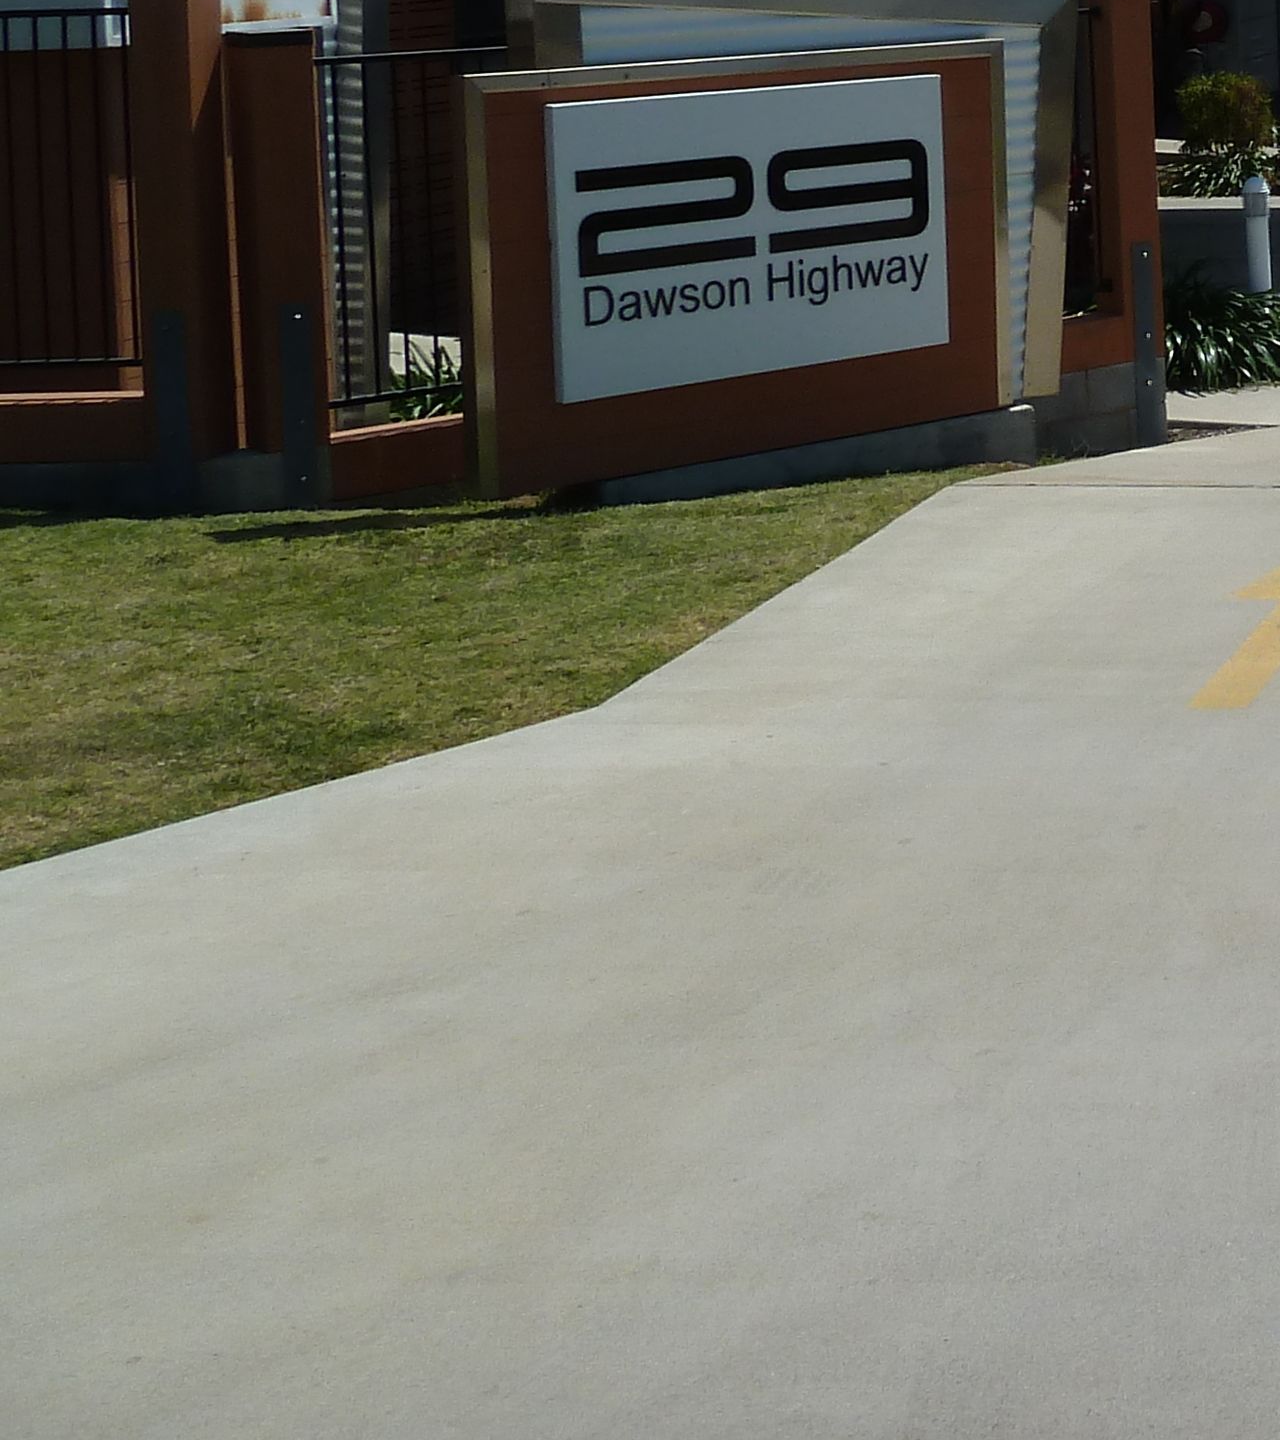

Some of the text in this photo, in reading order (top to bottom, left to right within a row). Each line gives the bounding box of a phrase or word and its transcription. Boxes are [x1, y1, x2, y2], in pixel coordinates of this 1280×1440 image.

[575, 138, 930, 277] 29
[583, 252, 929, 327] Dawson Highway
